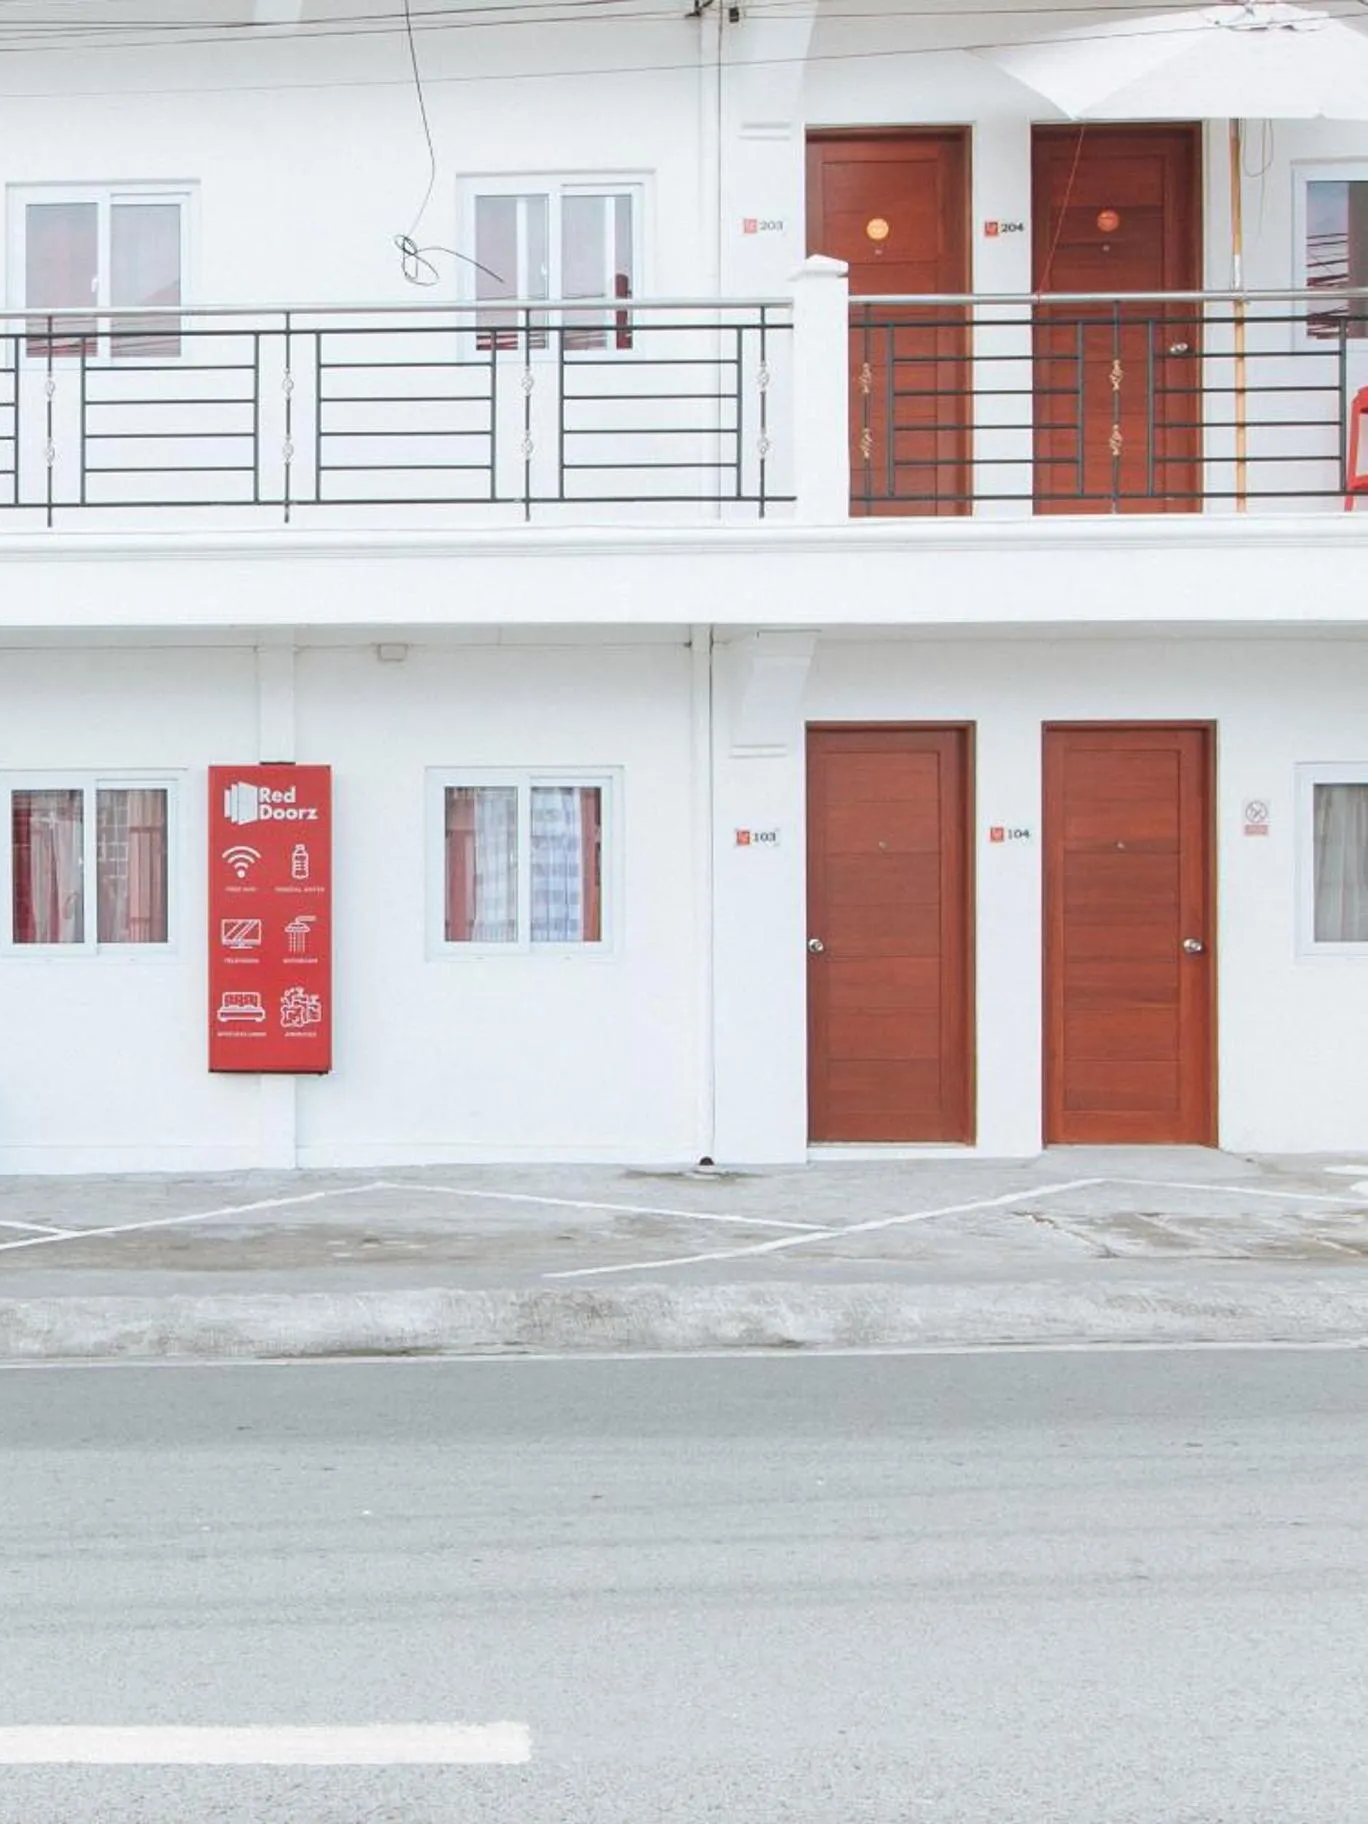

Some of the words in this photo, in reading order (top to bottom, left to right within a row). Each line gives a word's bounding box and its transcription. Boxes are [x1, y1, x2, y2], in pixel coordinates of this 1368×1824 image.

[1001, 222, 1024, 233] 204
[259, 785, 296, 804] Red
[260, 804, 319, 820] Doorz
[754, 831, 776, 842] 103
[1008, 828, 1030, 840] 104
